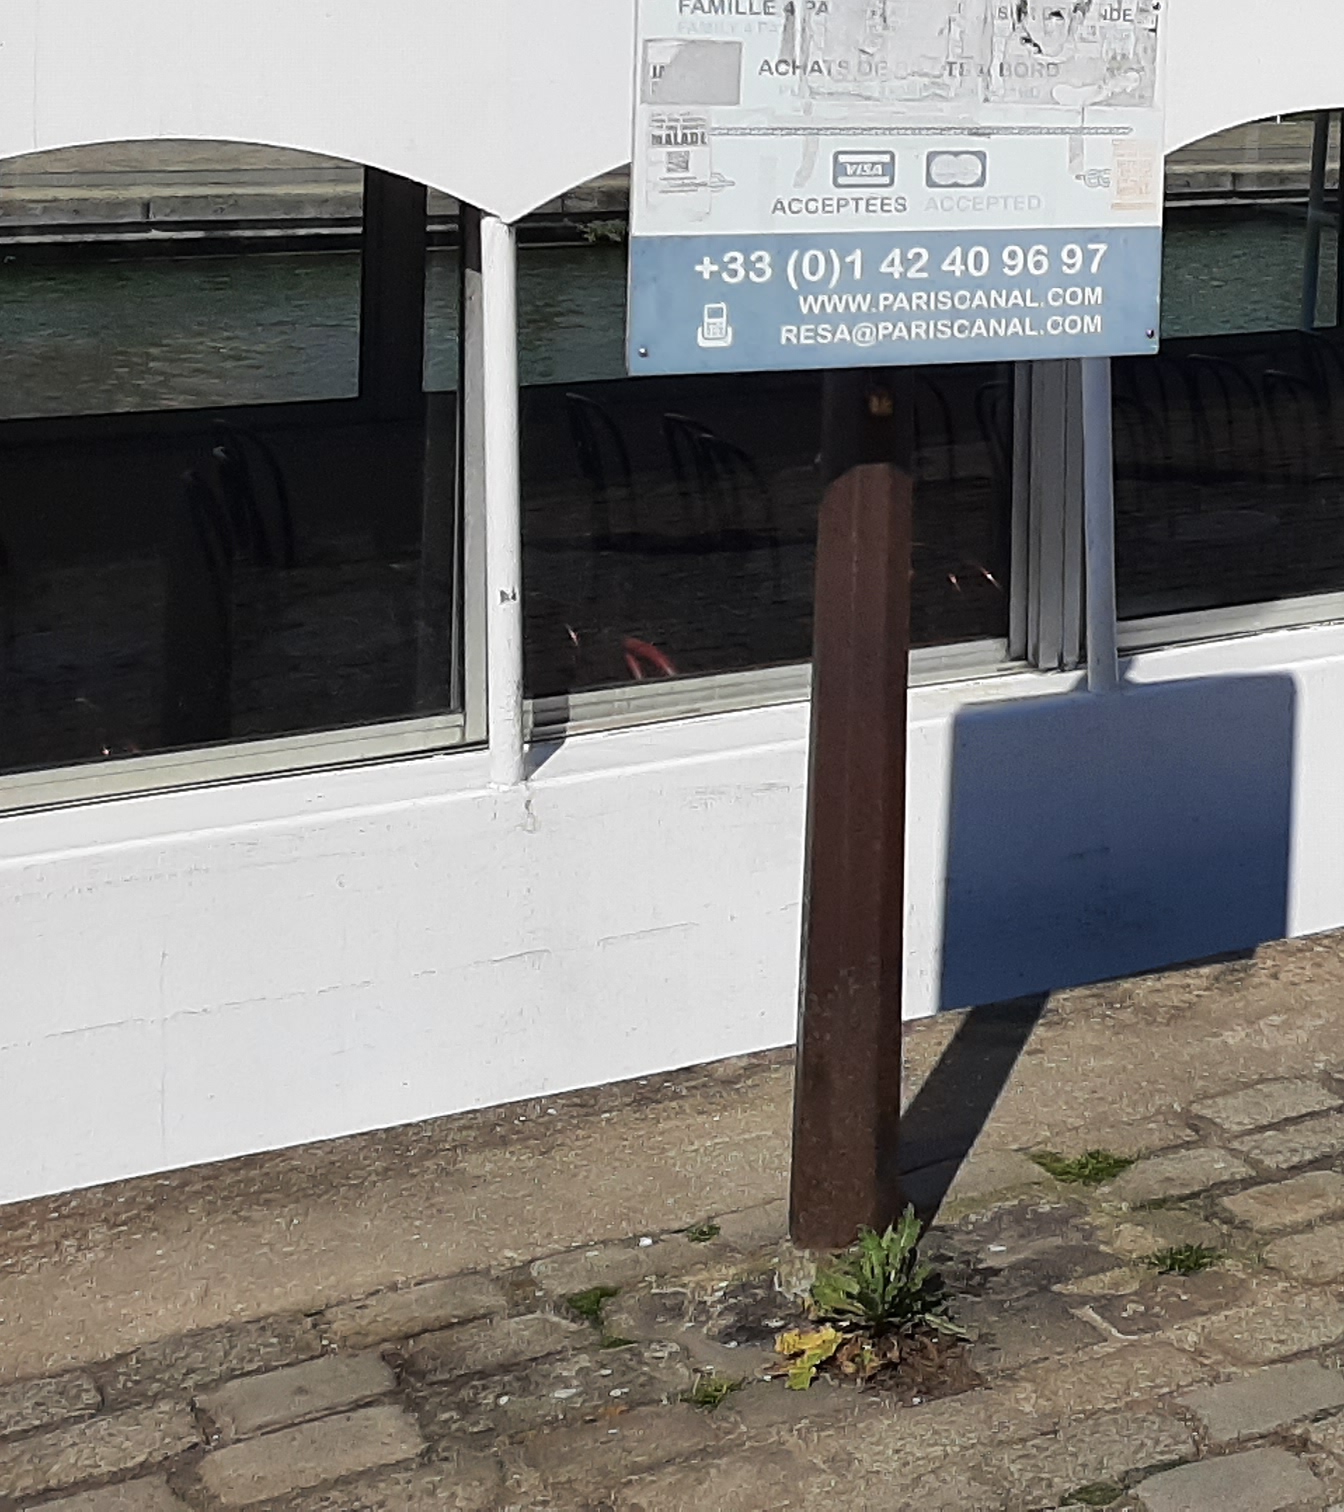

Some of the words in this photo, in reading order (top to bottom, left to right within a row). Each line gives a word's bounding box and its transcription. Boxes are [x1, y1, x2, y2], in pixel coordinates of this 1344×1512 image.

[843, 161, 884, 176] VISA
[925, 193, 1042, 214] ACCEPTED
[694, 250, 773, 284] +33
[786, 247, 864, 291] (0)1
[878, 246, 930, 280] 42
[940, 245, 990, 278] 40
[1001, 243, 1050, 276] 96
[1060, 242, 1108, 275] 97
[799, 286, 1102, 315] WWW.PARISCANAL.COM
[780, 315, 1102, 347] RESA@PARISCANAL.COM
